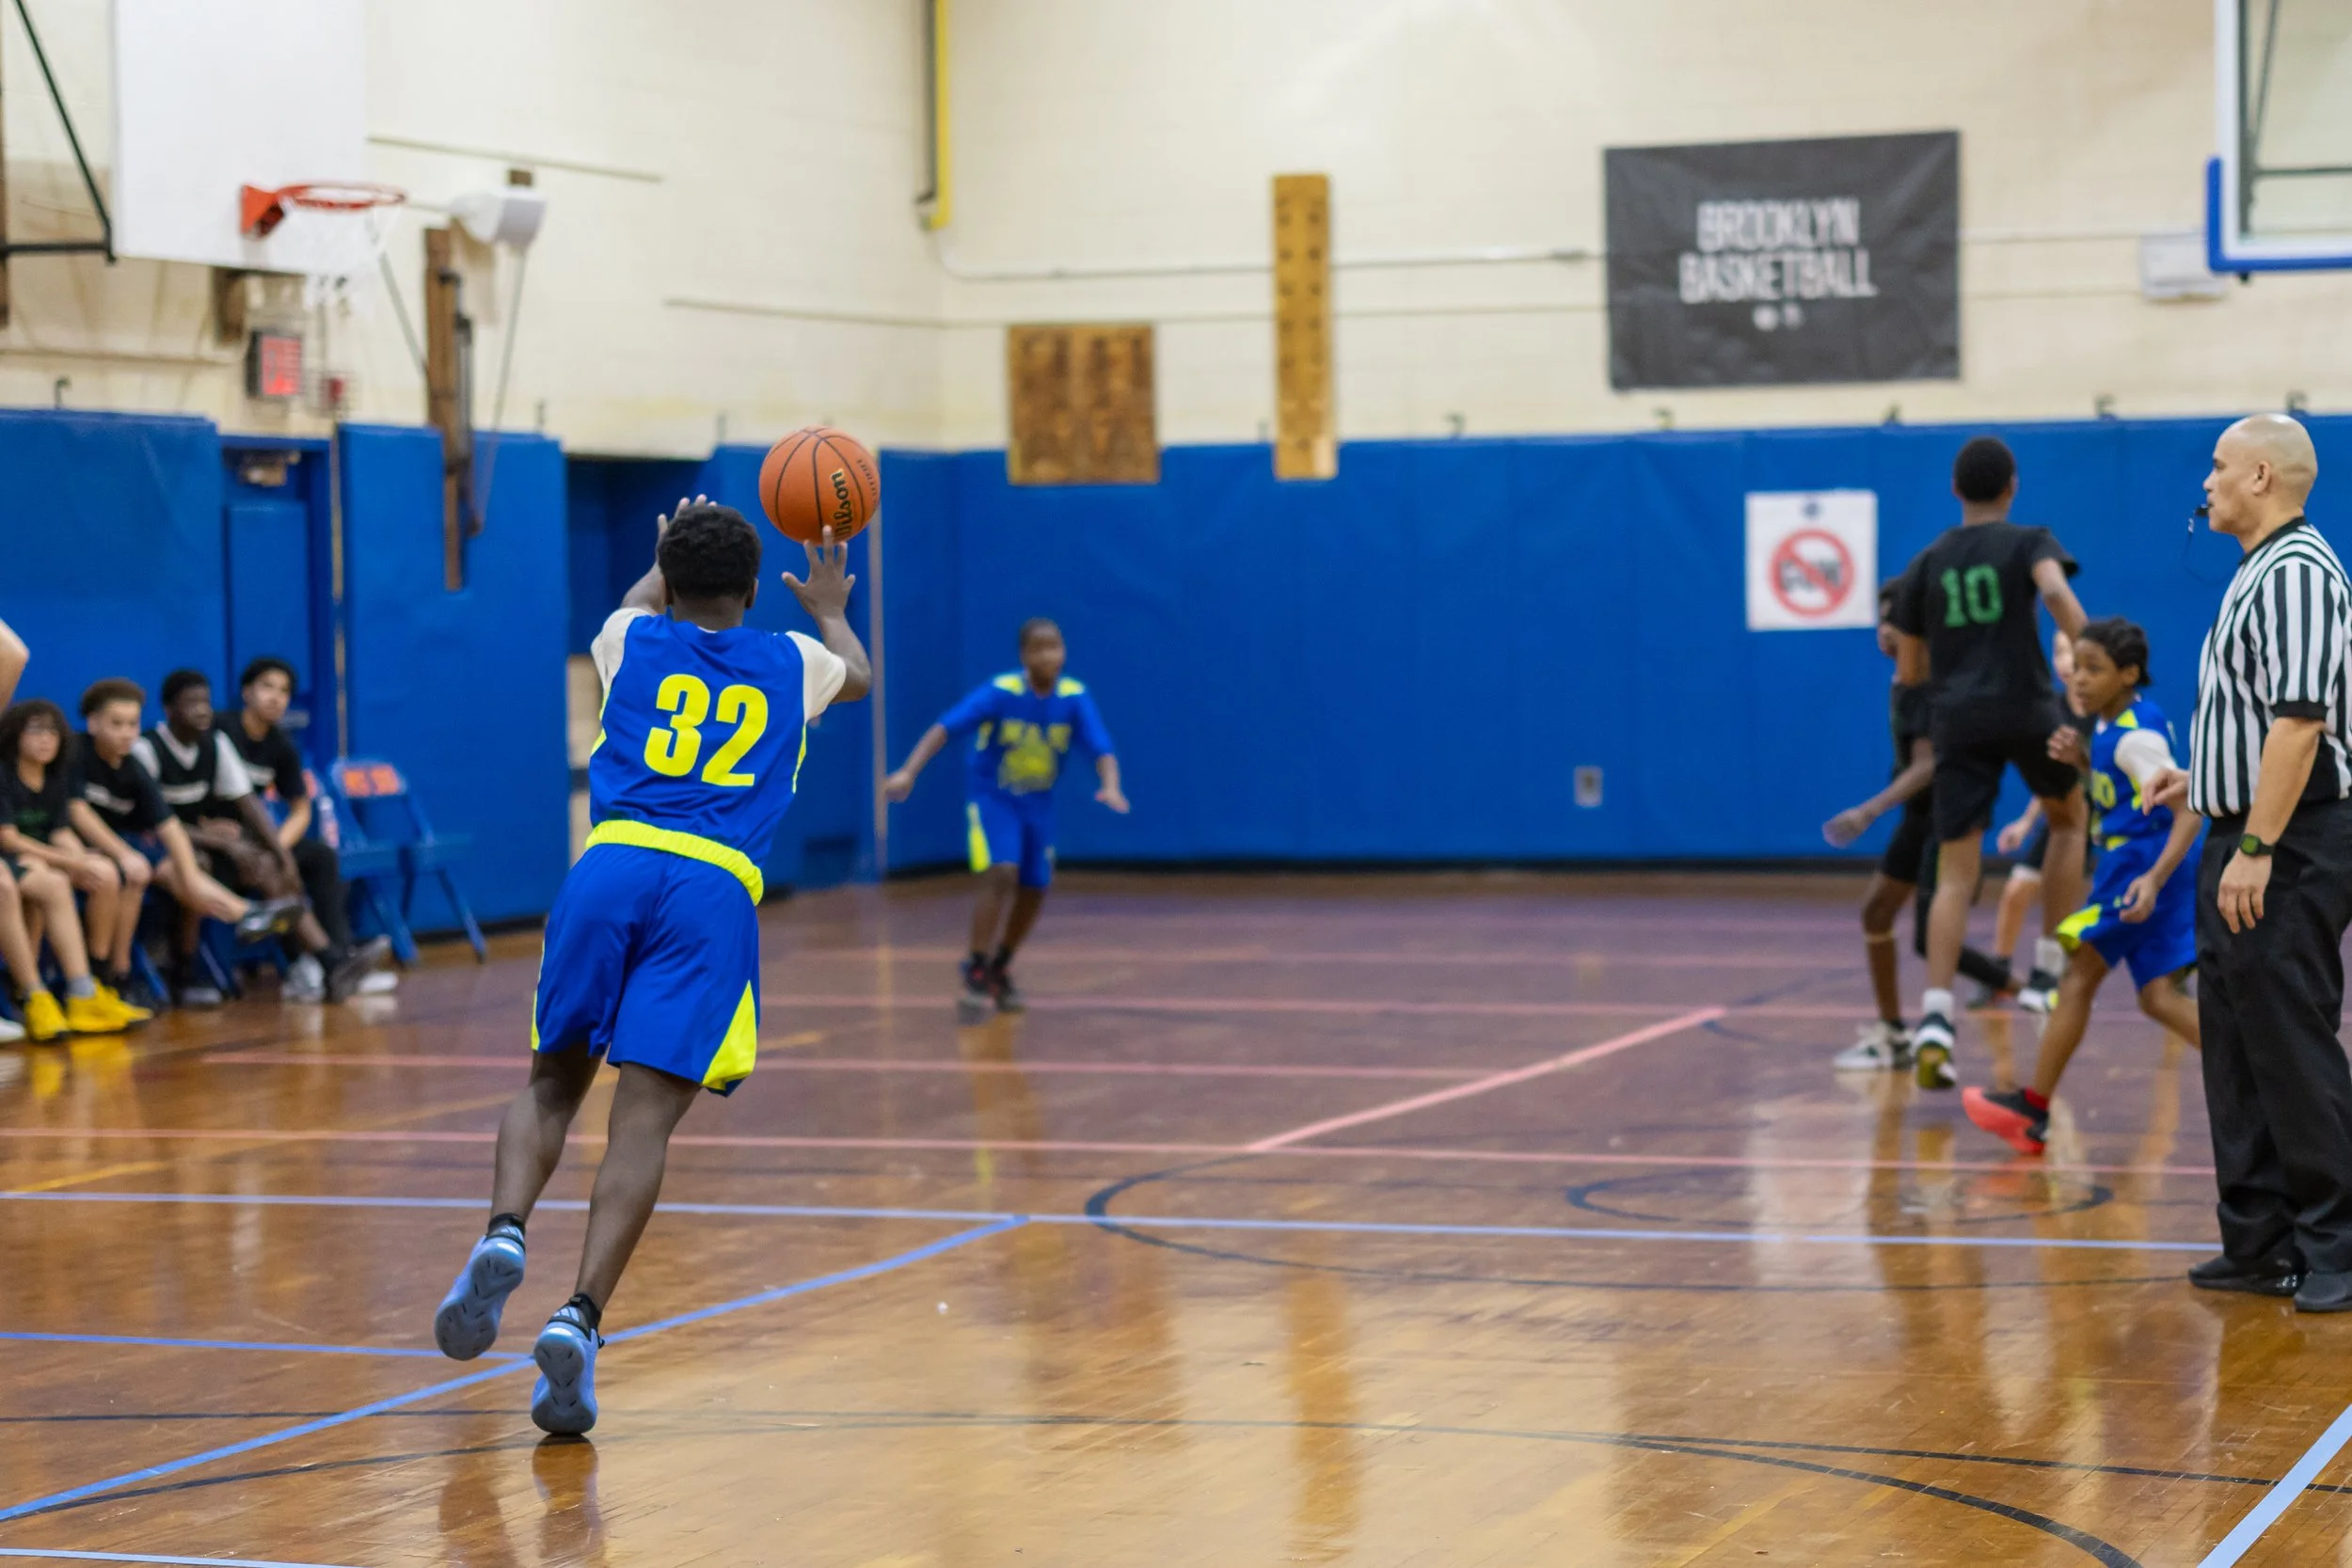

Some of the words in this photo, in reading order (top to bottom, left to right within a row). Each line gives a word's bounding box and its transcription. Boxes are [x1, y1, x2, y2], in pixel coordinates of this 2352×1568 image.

[1697, 198, 1860, 252] BROOKLYN
[1678, 248, 1878, 304] BASKETBALL
[1941, 565, 2003, 627] 10
[644, 673, 769, 786] 32
